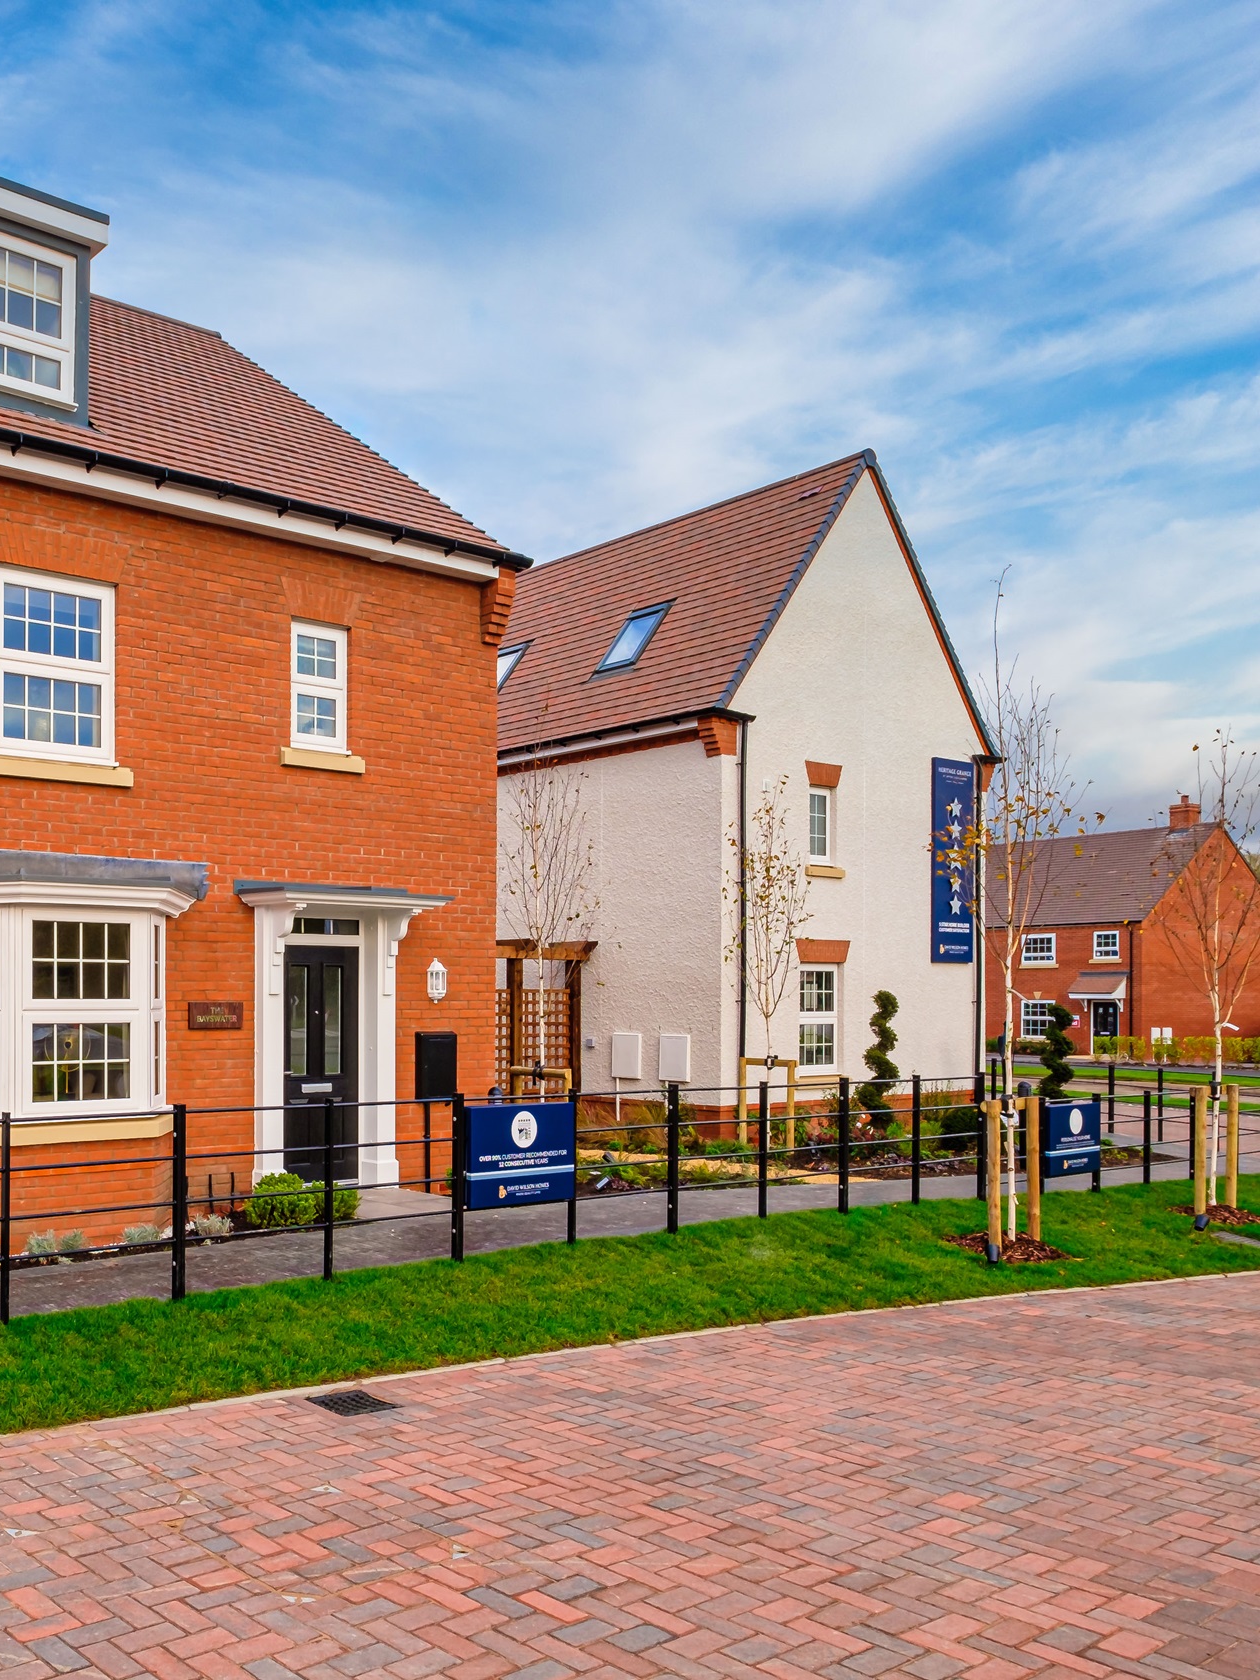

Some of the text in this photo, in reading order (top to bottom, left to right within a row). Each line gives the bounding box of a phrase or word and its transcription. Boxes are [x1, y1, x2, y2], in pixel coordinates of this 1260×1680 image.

[210, 1006, 224, 1014] THE
[196, 1014, 238, 1023] BAYSWATER
[502, 1152, 526, 1160] CUSTOMER
[526, 1150, 558, 1158] RECOMMENDED
[504, 1159, 535, 1167] CONSECUTIVE
